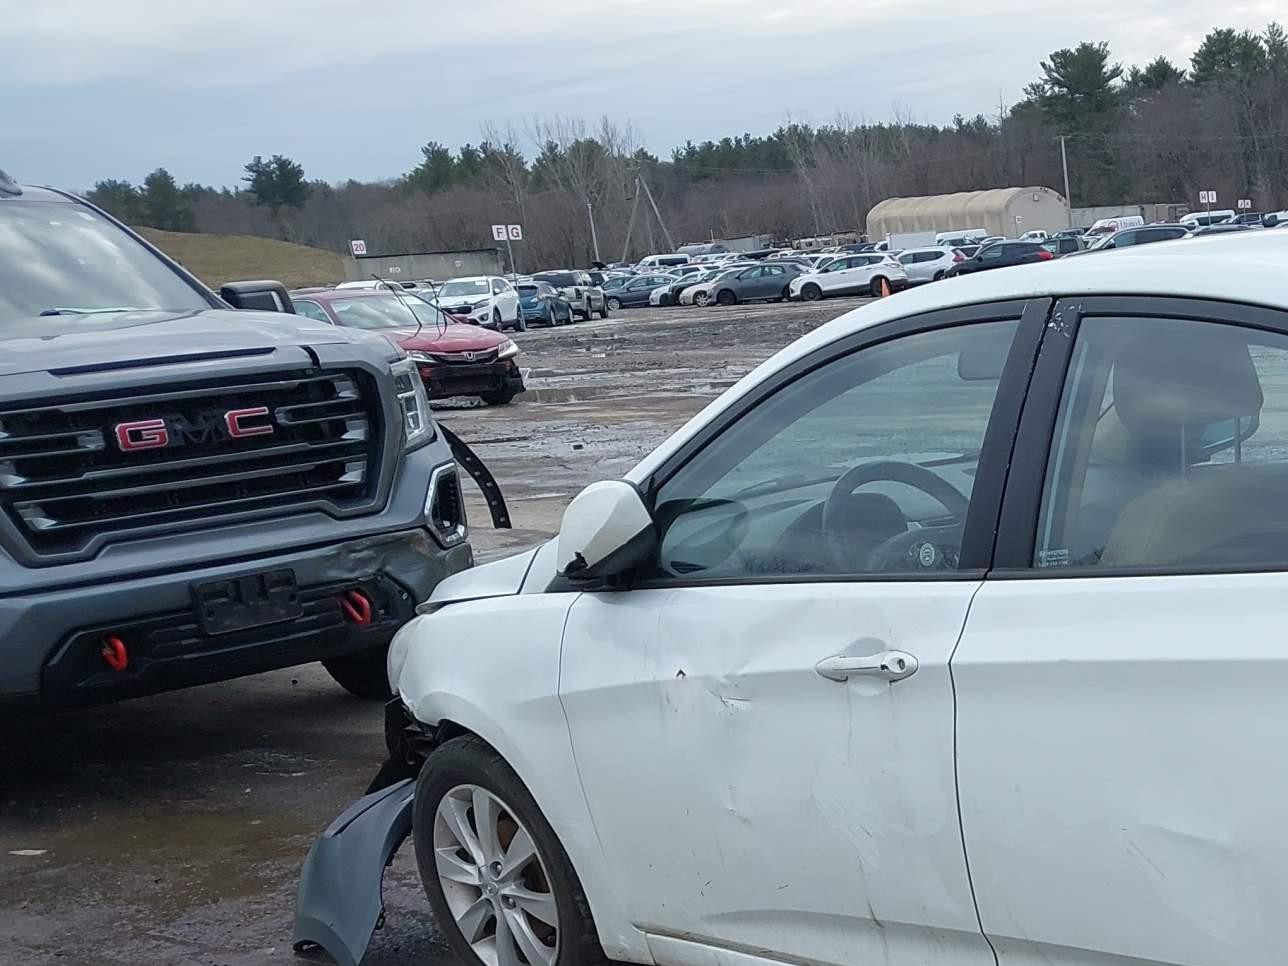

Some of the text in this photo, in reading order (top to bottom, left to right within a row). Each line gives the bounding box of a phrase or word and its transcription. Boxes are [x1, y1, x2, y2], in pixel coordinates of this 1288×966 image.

[496, 227, 520, 238] F G
[353, 243, 365, 252] 20
